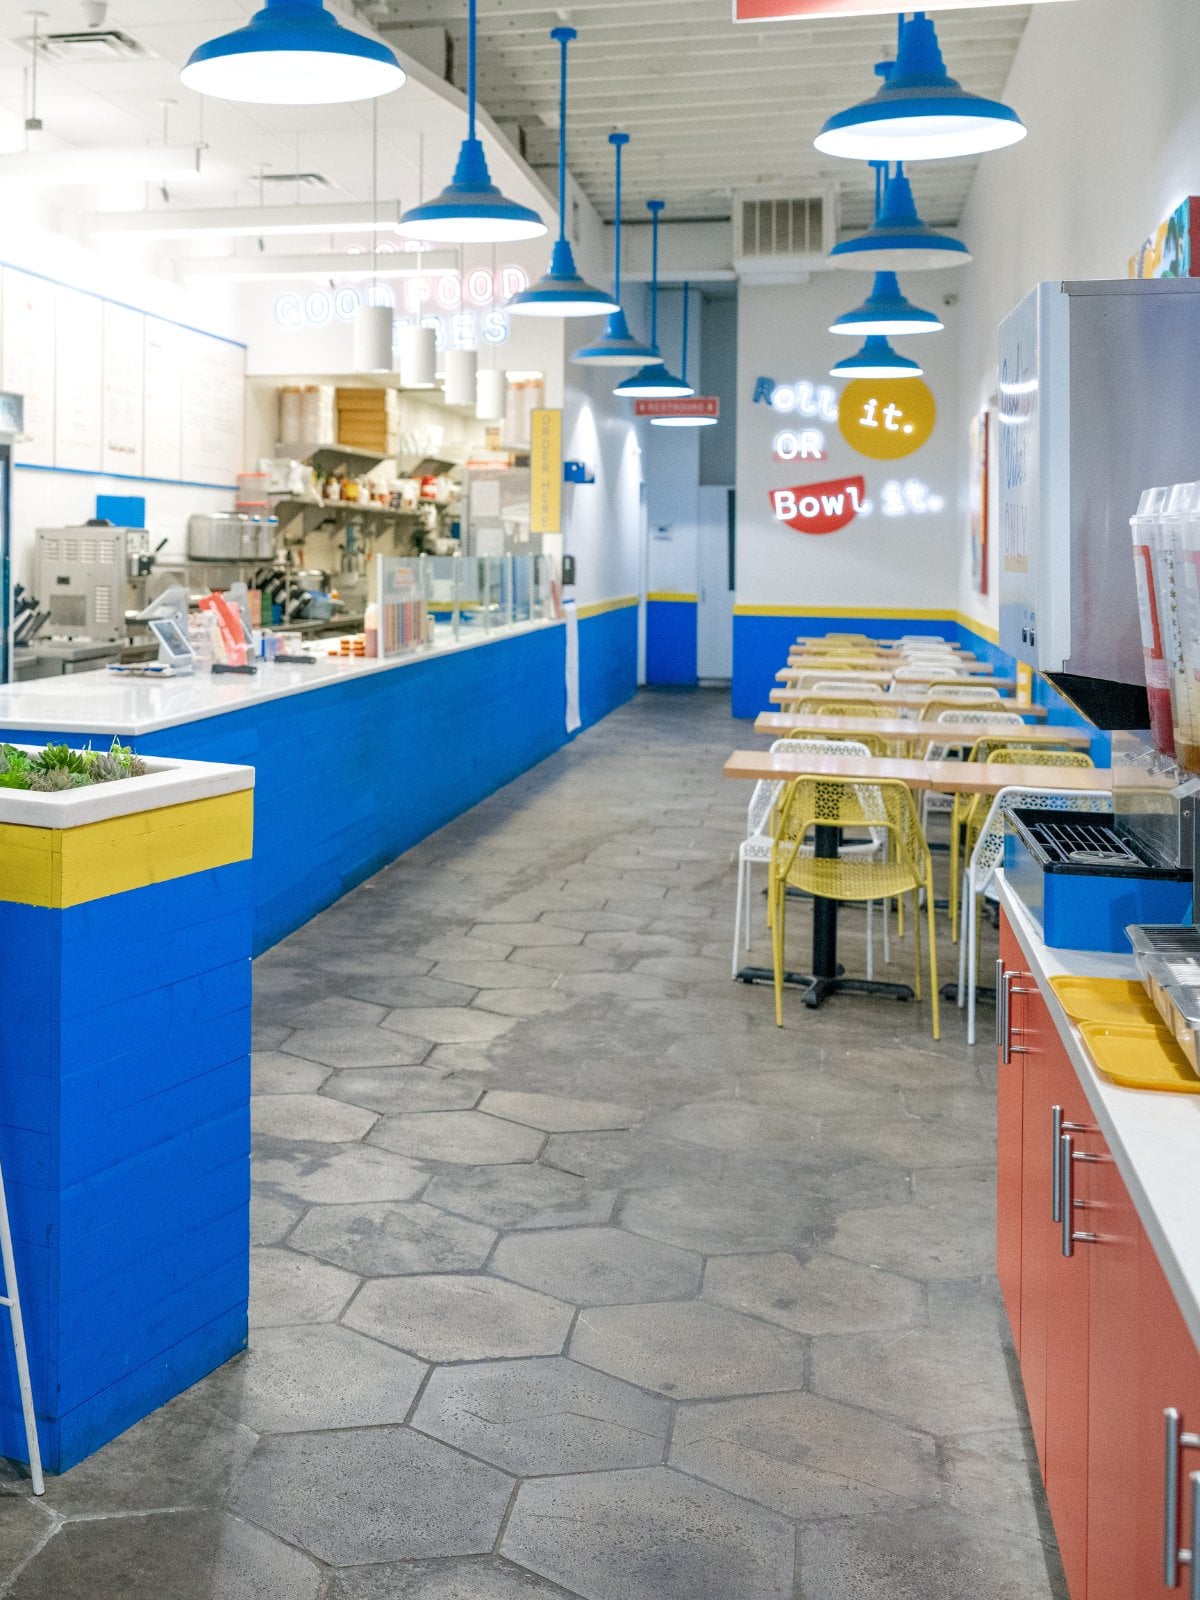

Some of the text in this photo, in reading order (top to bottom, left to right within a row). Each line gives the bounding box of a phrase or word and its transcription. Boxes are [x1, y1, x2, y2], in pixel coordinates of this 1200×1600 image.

[753, 376, 914, 433] Roll it.
[776, 431, 822, 460] OR
[774, 481, 943, 521] Bowl it.
